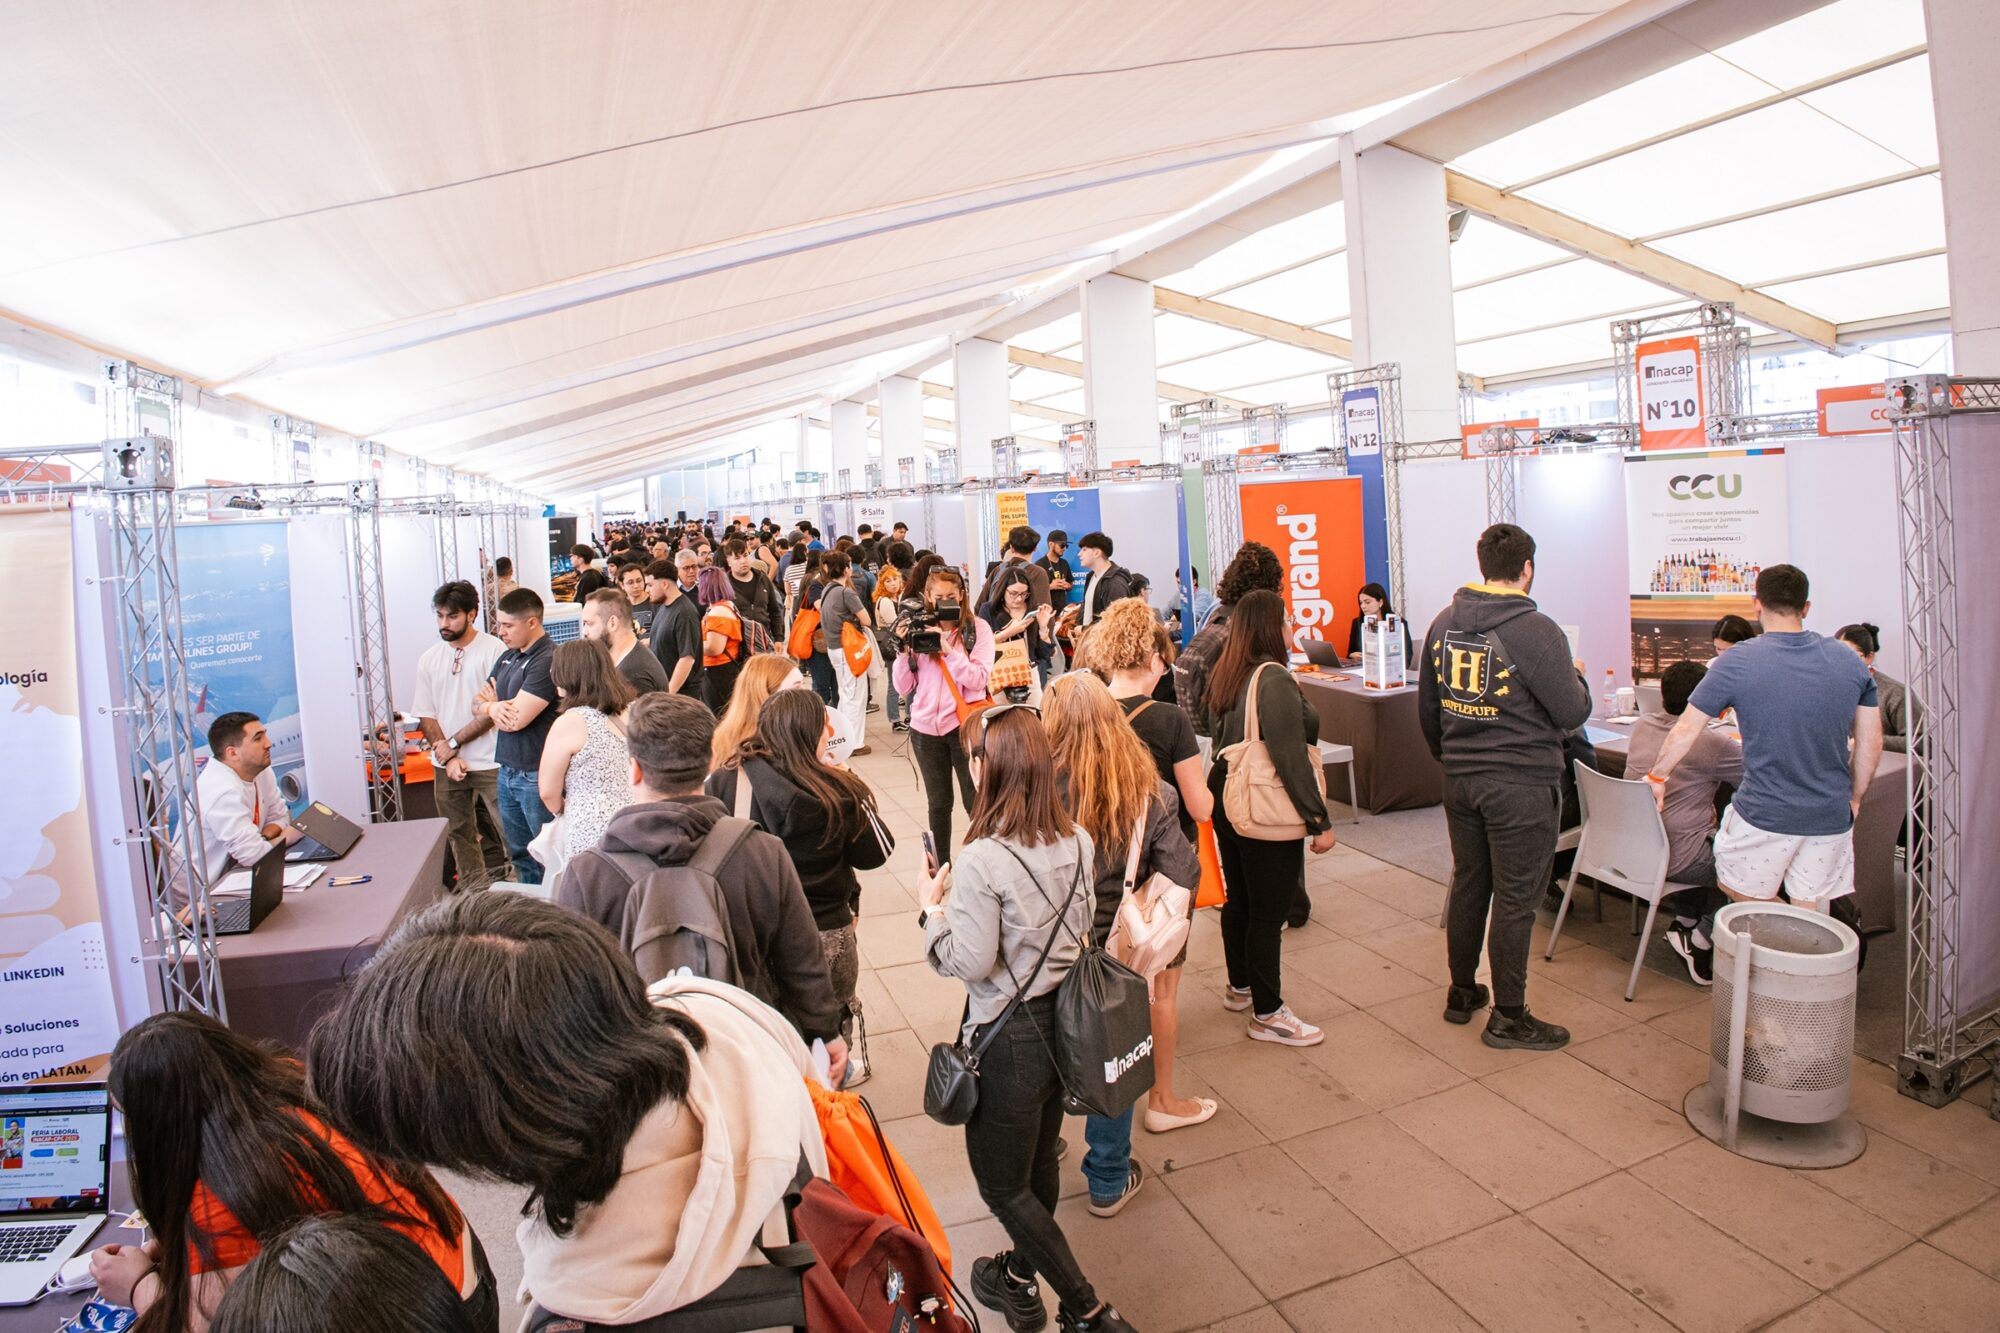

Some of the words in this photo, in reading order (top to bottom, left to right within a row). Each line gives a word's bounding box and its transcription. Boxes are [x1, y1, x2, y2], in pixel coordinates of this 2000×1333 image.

[1645, 365, 1694, 379] inacap
[1647, 399, 1696, 421] N°10
[1870, 408, 1889, 421] CC
[1350, 433, 1377, 448] N°12
[1183, 452, 1200, 463] N°14
[1668, 474, 1742, 501] CCU
[868, 508, 885, 516] Salfa
[196, 635, 214, 646] SER
[216, 632, 246, 643] PARTE
[247, 630, 260, 640] DE
[216, 642, 253, 654] GROUP!
[190, 660, 226, 670] Queremos
[228, 654, 263, 665] conocerte
[1450, 648, 1486, 694] H
[4, 967, 64, 982] LINKEDIN
[5, 1019, 79, 1034] Soluciones
[0, 1046, 28, 1059] ada
[33, 1044, 64, 1059] para
[1104, 1035, 1153, 1083] inacap
[22, 1071, 39, 1080] en
[42, 1065, 91, 1078] LATAM.
